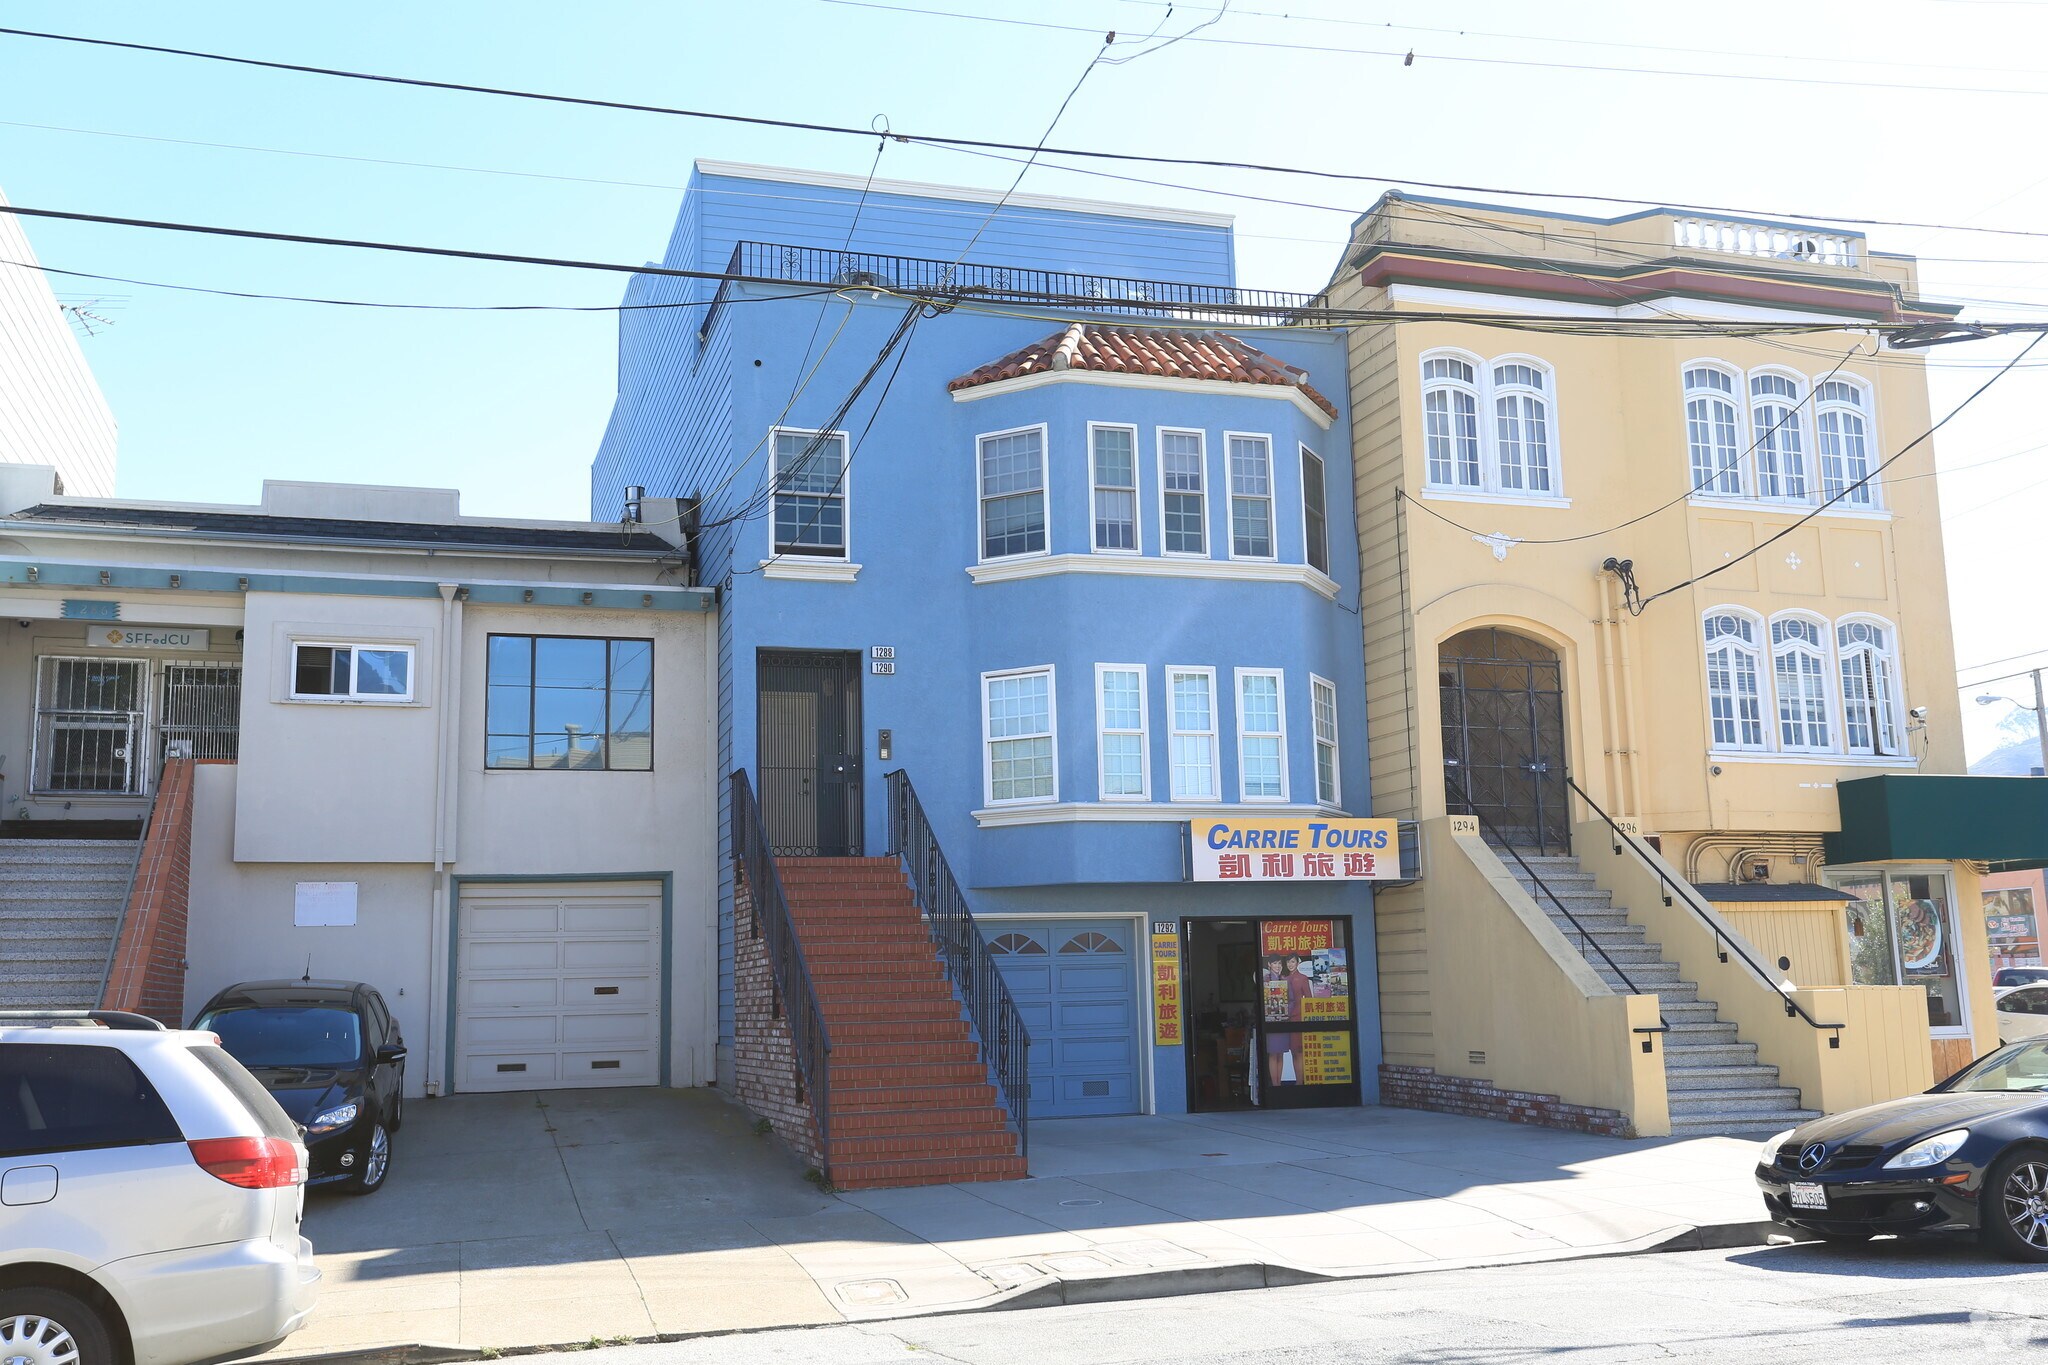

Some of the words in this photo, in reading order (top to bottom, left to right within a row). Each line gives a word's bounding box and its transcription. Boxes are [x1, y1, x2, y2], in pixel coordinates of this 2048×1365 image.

[126, 632, 190, 645] SFFedCU
[875, 647, 893, 657] 1288
[875, 663, 893, 673] 1290
[1453, 820, 1475, 832] 1294
[1207, 824, 1300, 850] CARRIE
[1308, 823, 1388, 849] TOURS
[1218, 853, 1376, 879] 凱利旅遊
[1157, 923, 1174, 933] 1292
[1264, 921, 1297, 933] Carrie
[1300, 920, 1329, 933] Tours
[1267, 935, 1327, 951] 凱利旅遊
[1155, 950, 1177, 958] TOURS
[1157, 965, 1178, 1039] 凱利旅遊
